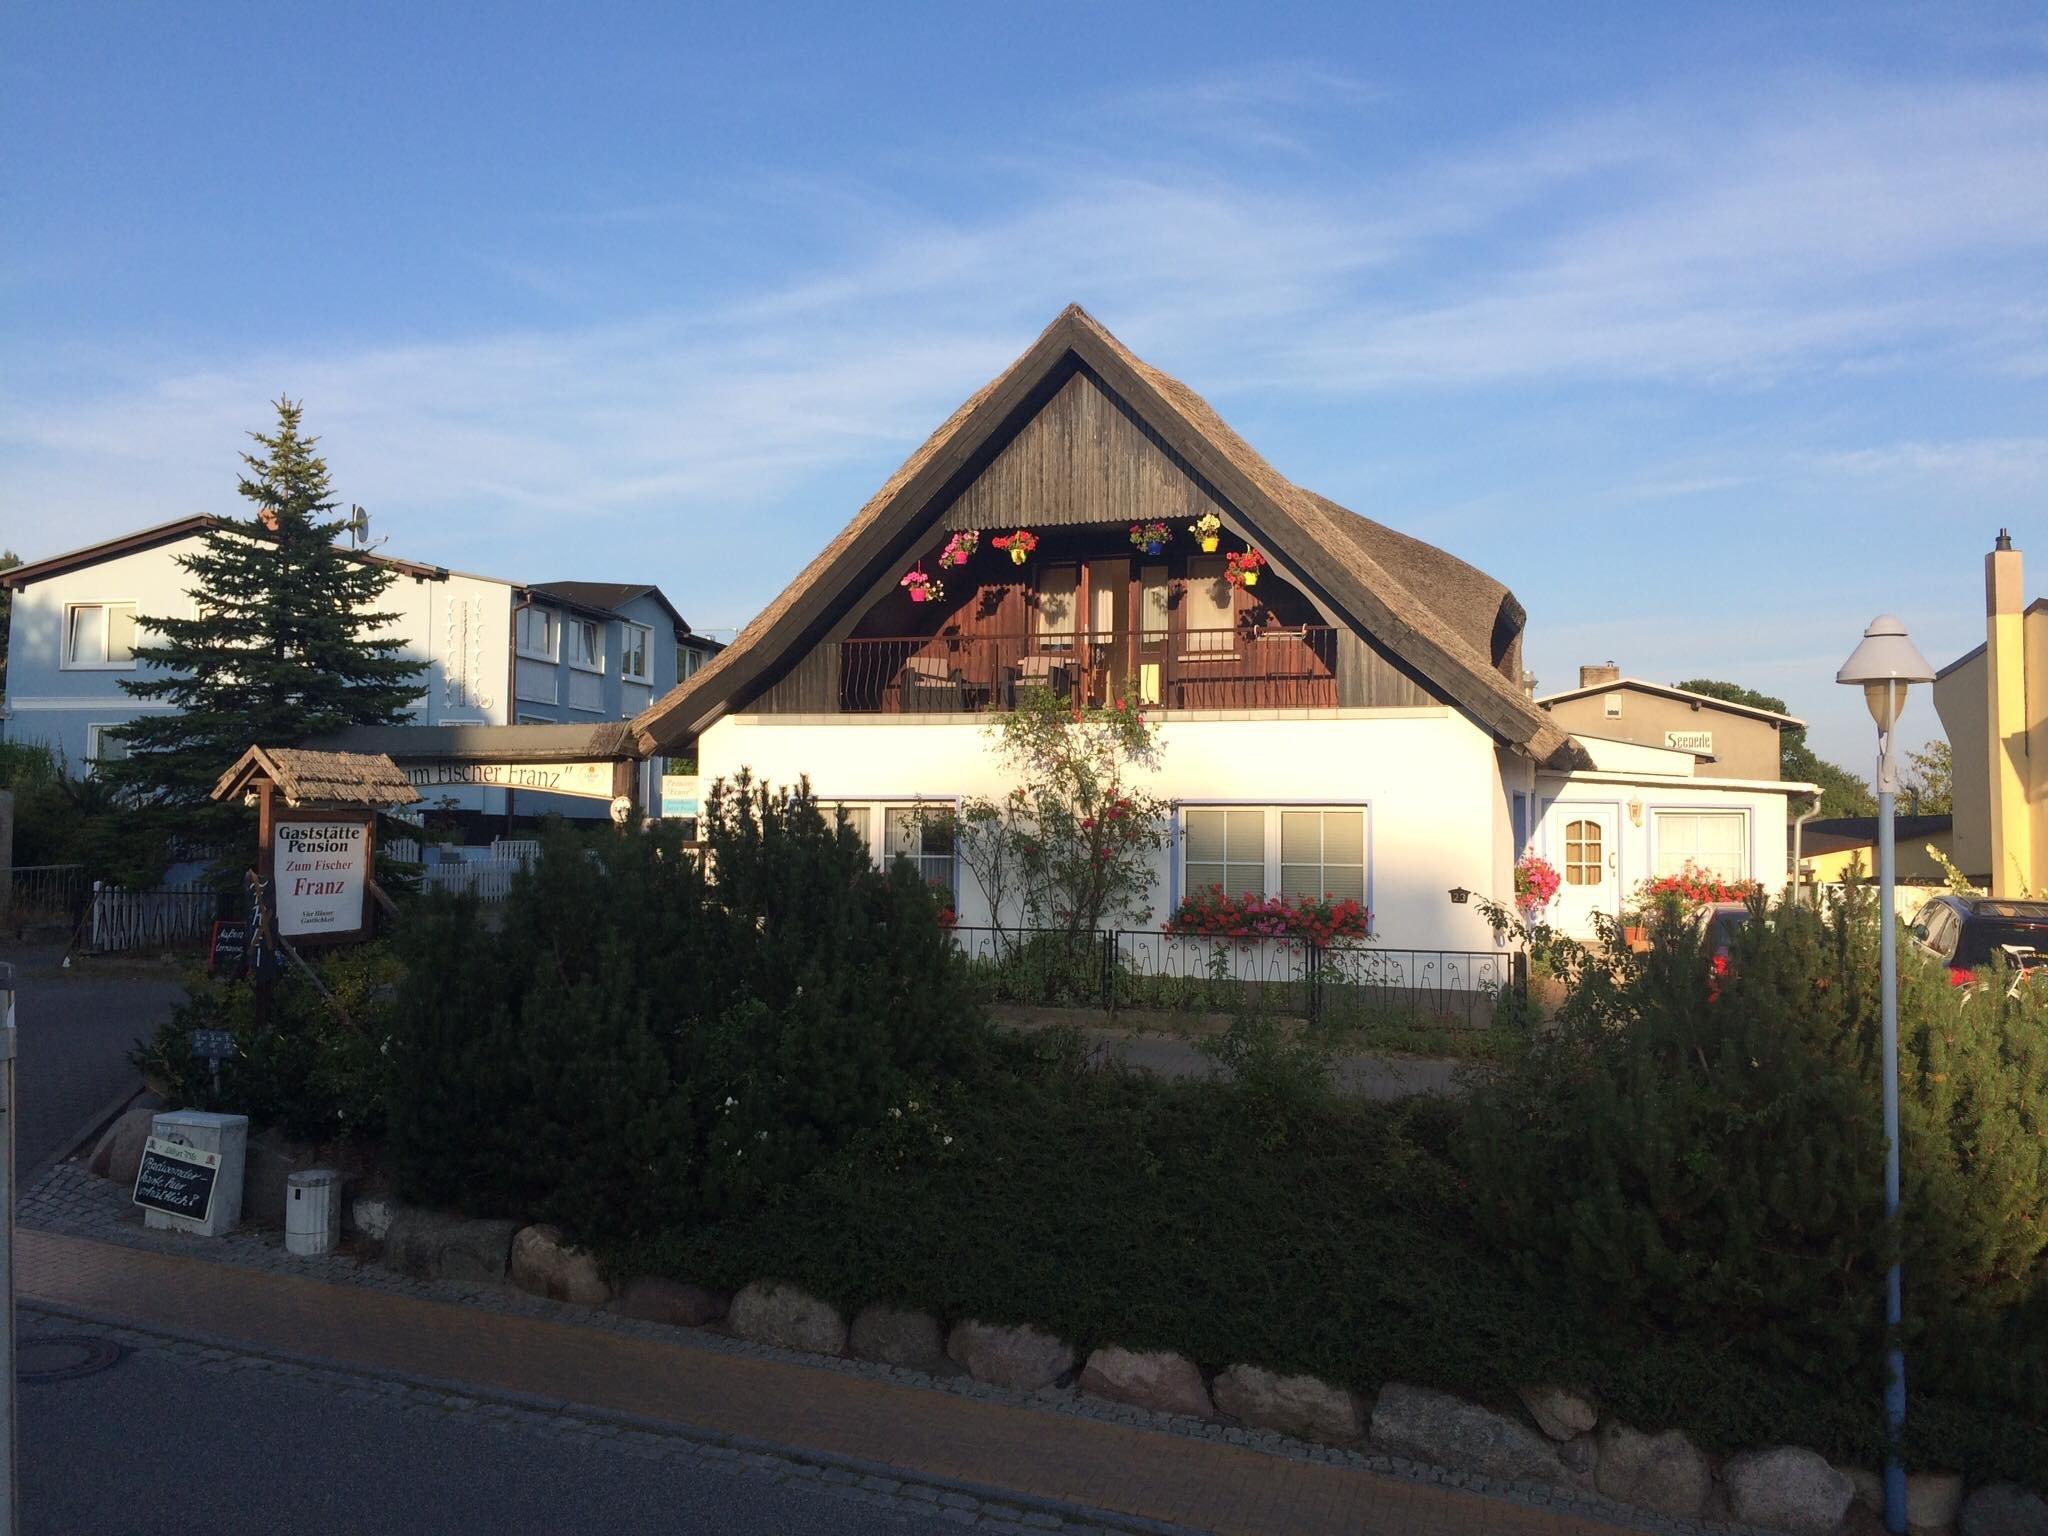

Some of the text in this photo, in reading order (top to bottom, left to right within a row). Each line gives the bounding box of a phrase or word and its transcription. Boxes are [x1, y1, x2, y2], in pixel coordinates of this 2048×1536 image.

[437, 761, 502, 782] Fischer
[278, 826, 361, 841] Gaststätte
[288, 840, 349, 853] Pension
[286, 860, 354, 872] Zum Fischer
[292, 878, 345, 896] Franz
